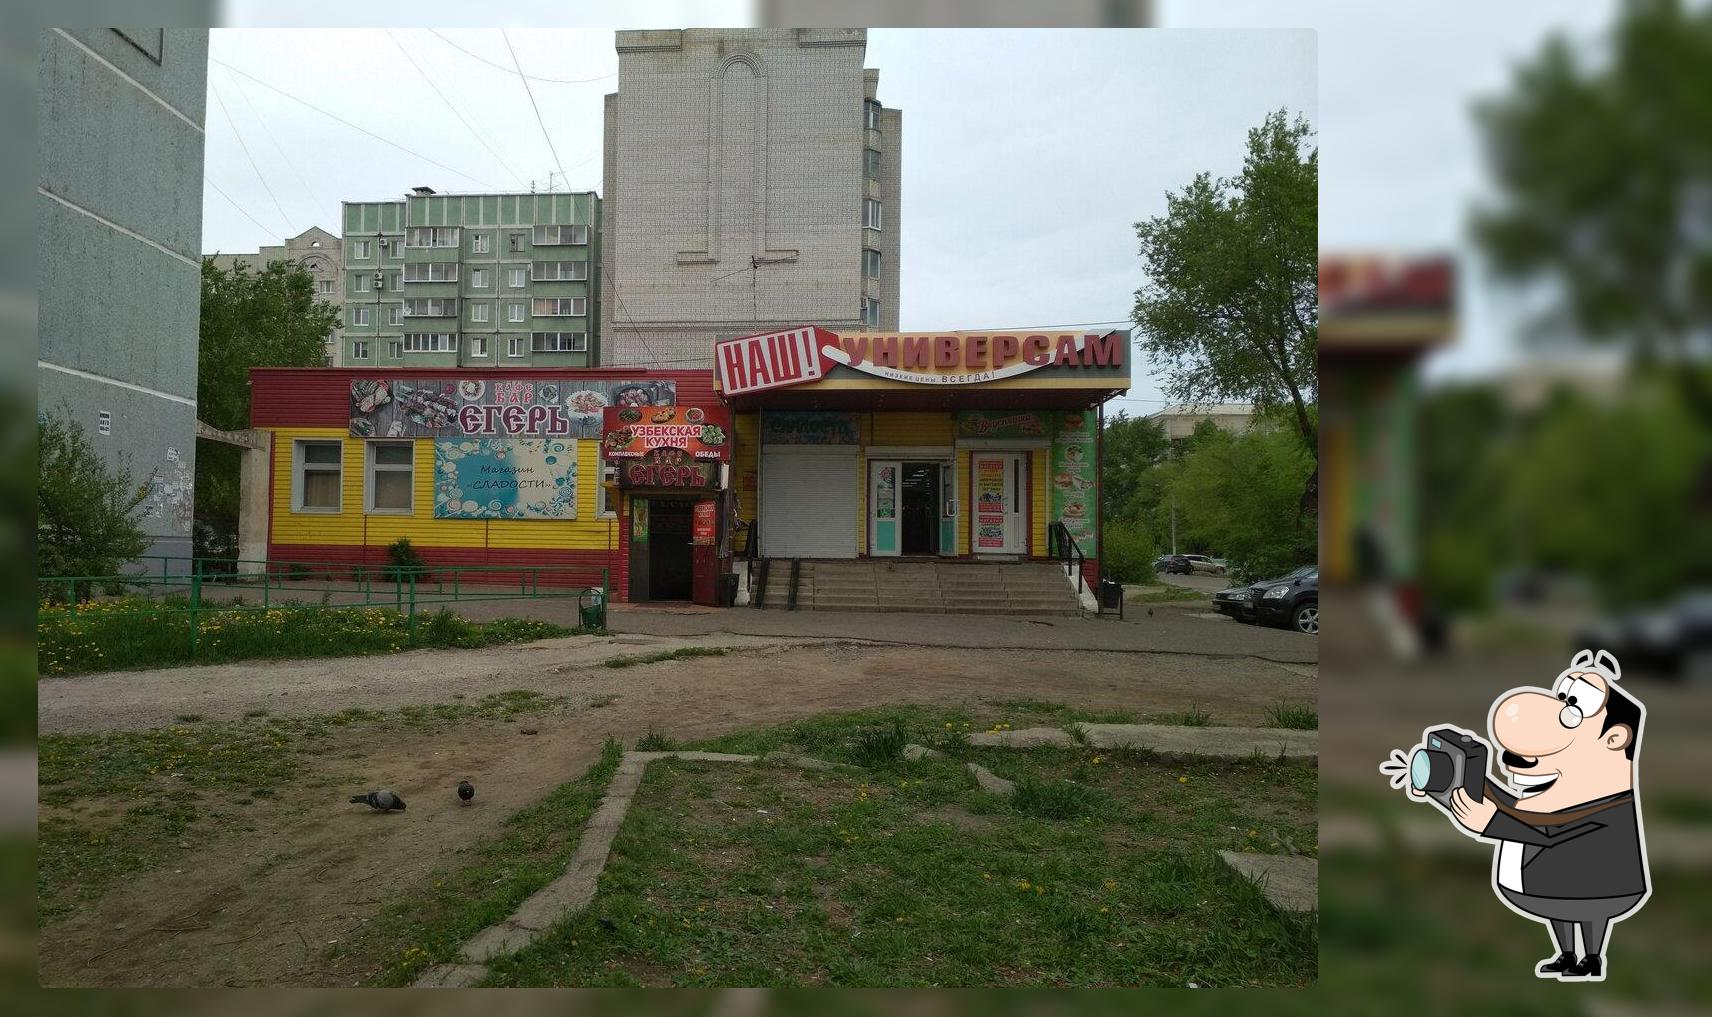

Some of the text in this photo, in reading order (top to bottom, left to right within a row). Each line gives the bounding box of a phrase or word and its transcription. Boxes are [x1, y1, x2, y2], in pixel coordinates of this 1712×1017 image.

[723, 330, 1123, 391] НАШ! УНИВЕРСАМ
[941, 371, 995, 384] ВСЕГДА!
[495, 383, 534, 392] КАФЕ
[495, 392, 534, 404] БАР
[458, 404, 569, 435] ЕГЕРЬ
[630, 425, 702, 437] УЗБЕКСКАЯ
[645, 437, 687, 448] КУХНЯ
[480, 465, 535, 475] Магазин
[629, 464, 706, 487] ЕГЕРЬ
